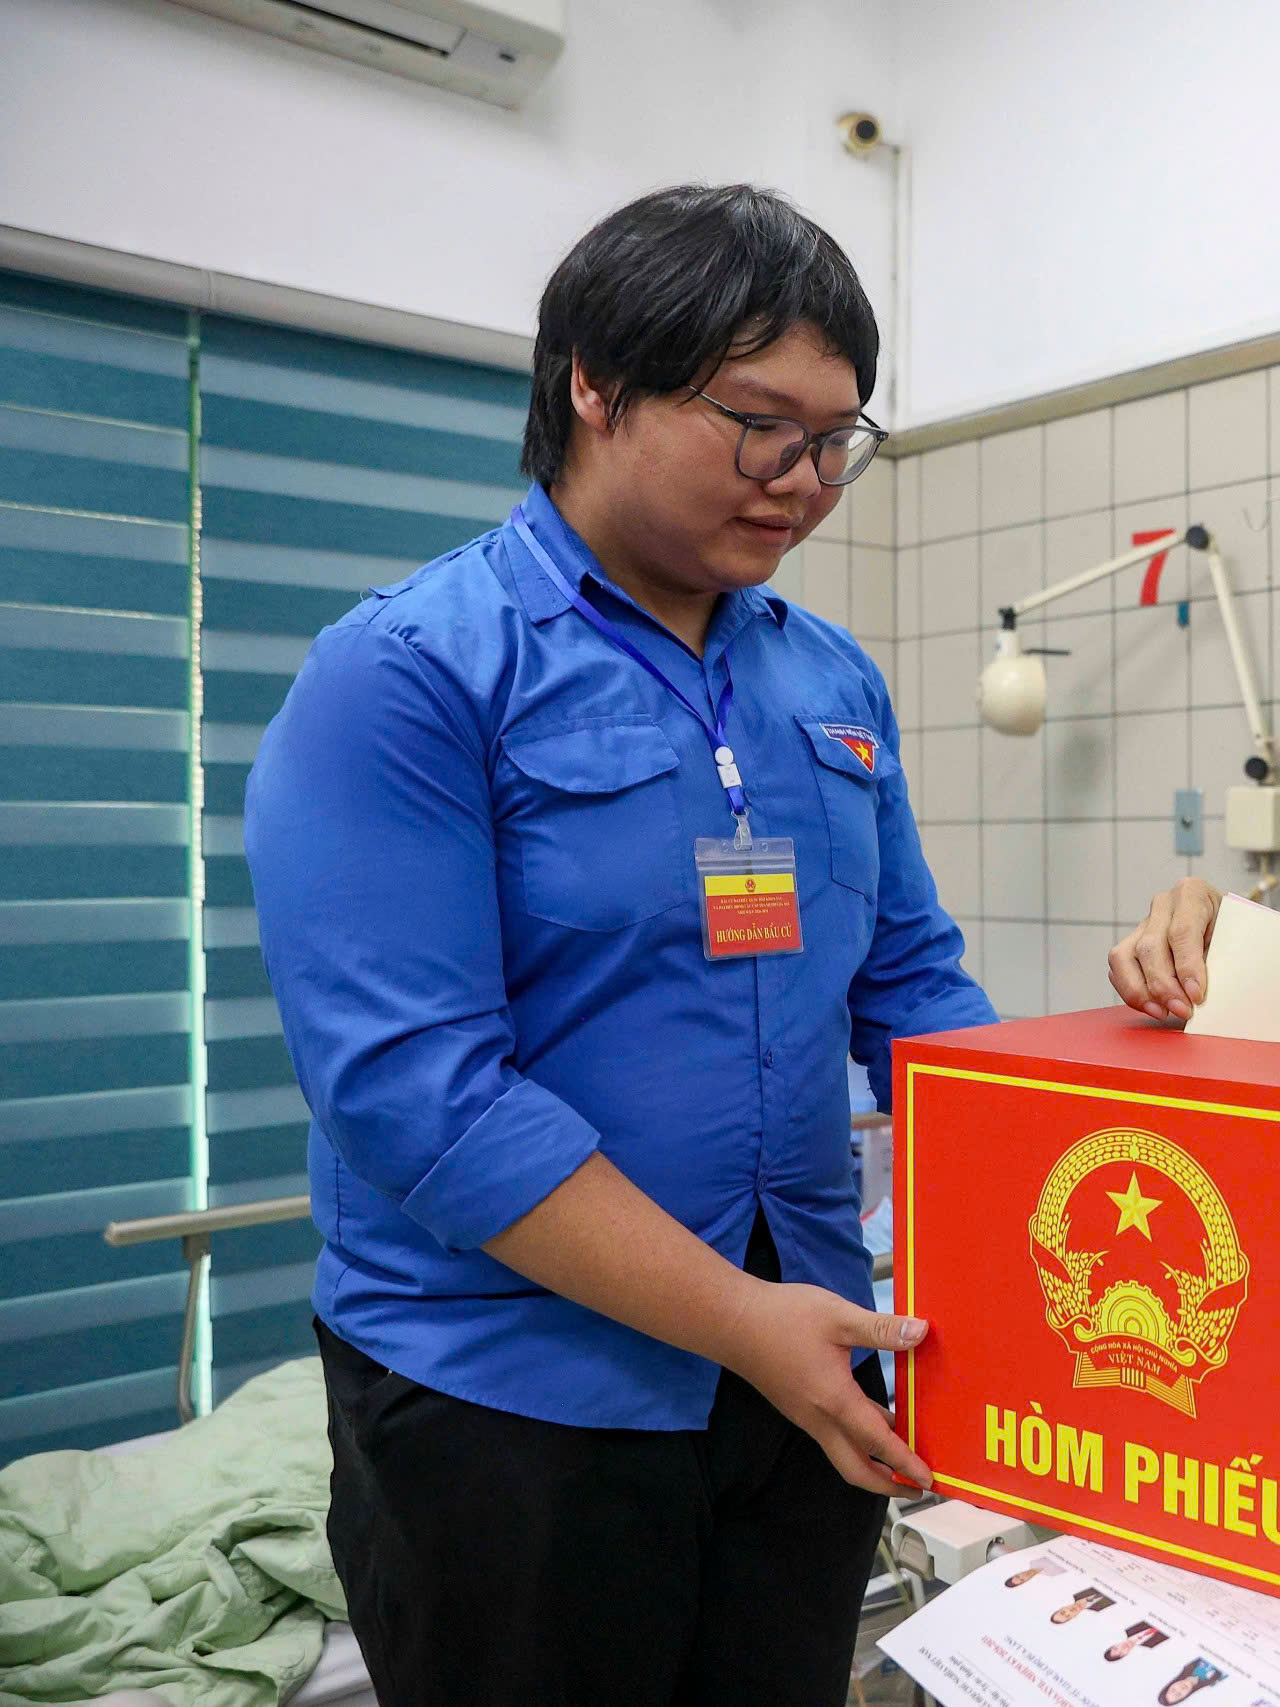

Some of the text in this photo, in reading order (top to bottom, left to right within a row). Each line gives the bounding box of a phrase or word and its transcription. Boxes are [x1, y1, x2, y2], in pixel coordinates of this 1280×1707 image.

[1131, 528, 1176, 607] 7
[1108, 1350, 1160, 1376] VIỆT NAM
[985, 1401, 1104, 1494] HÒM
